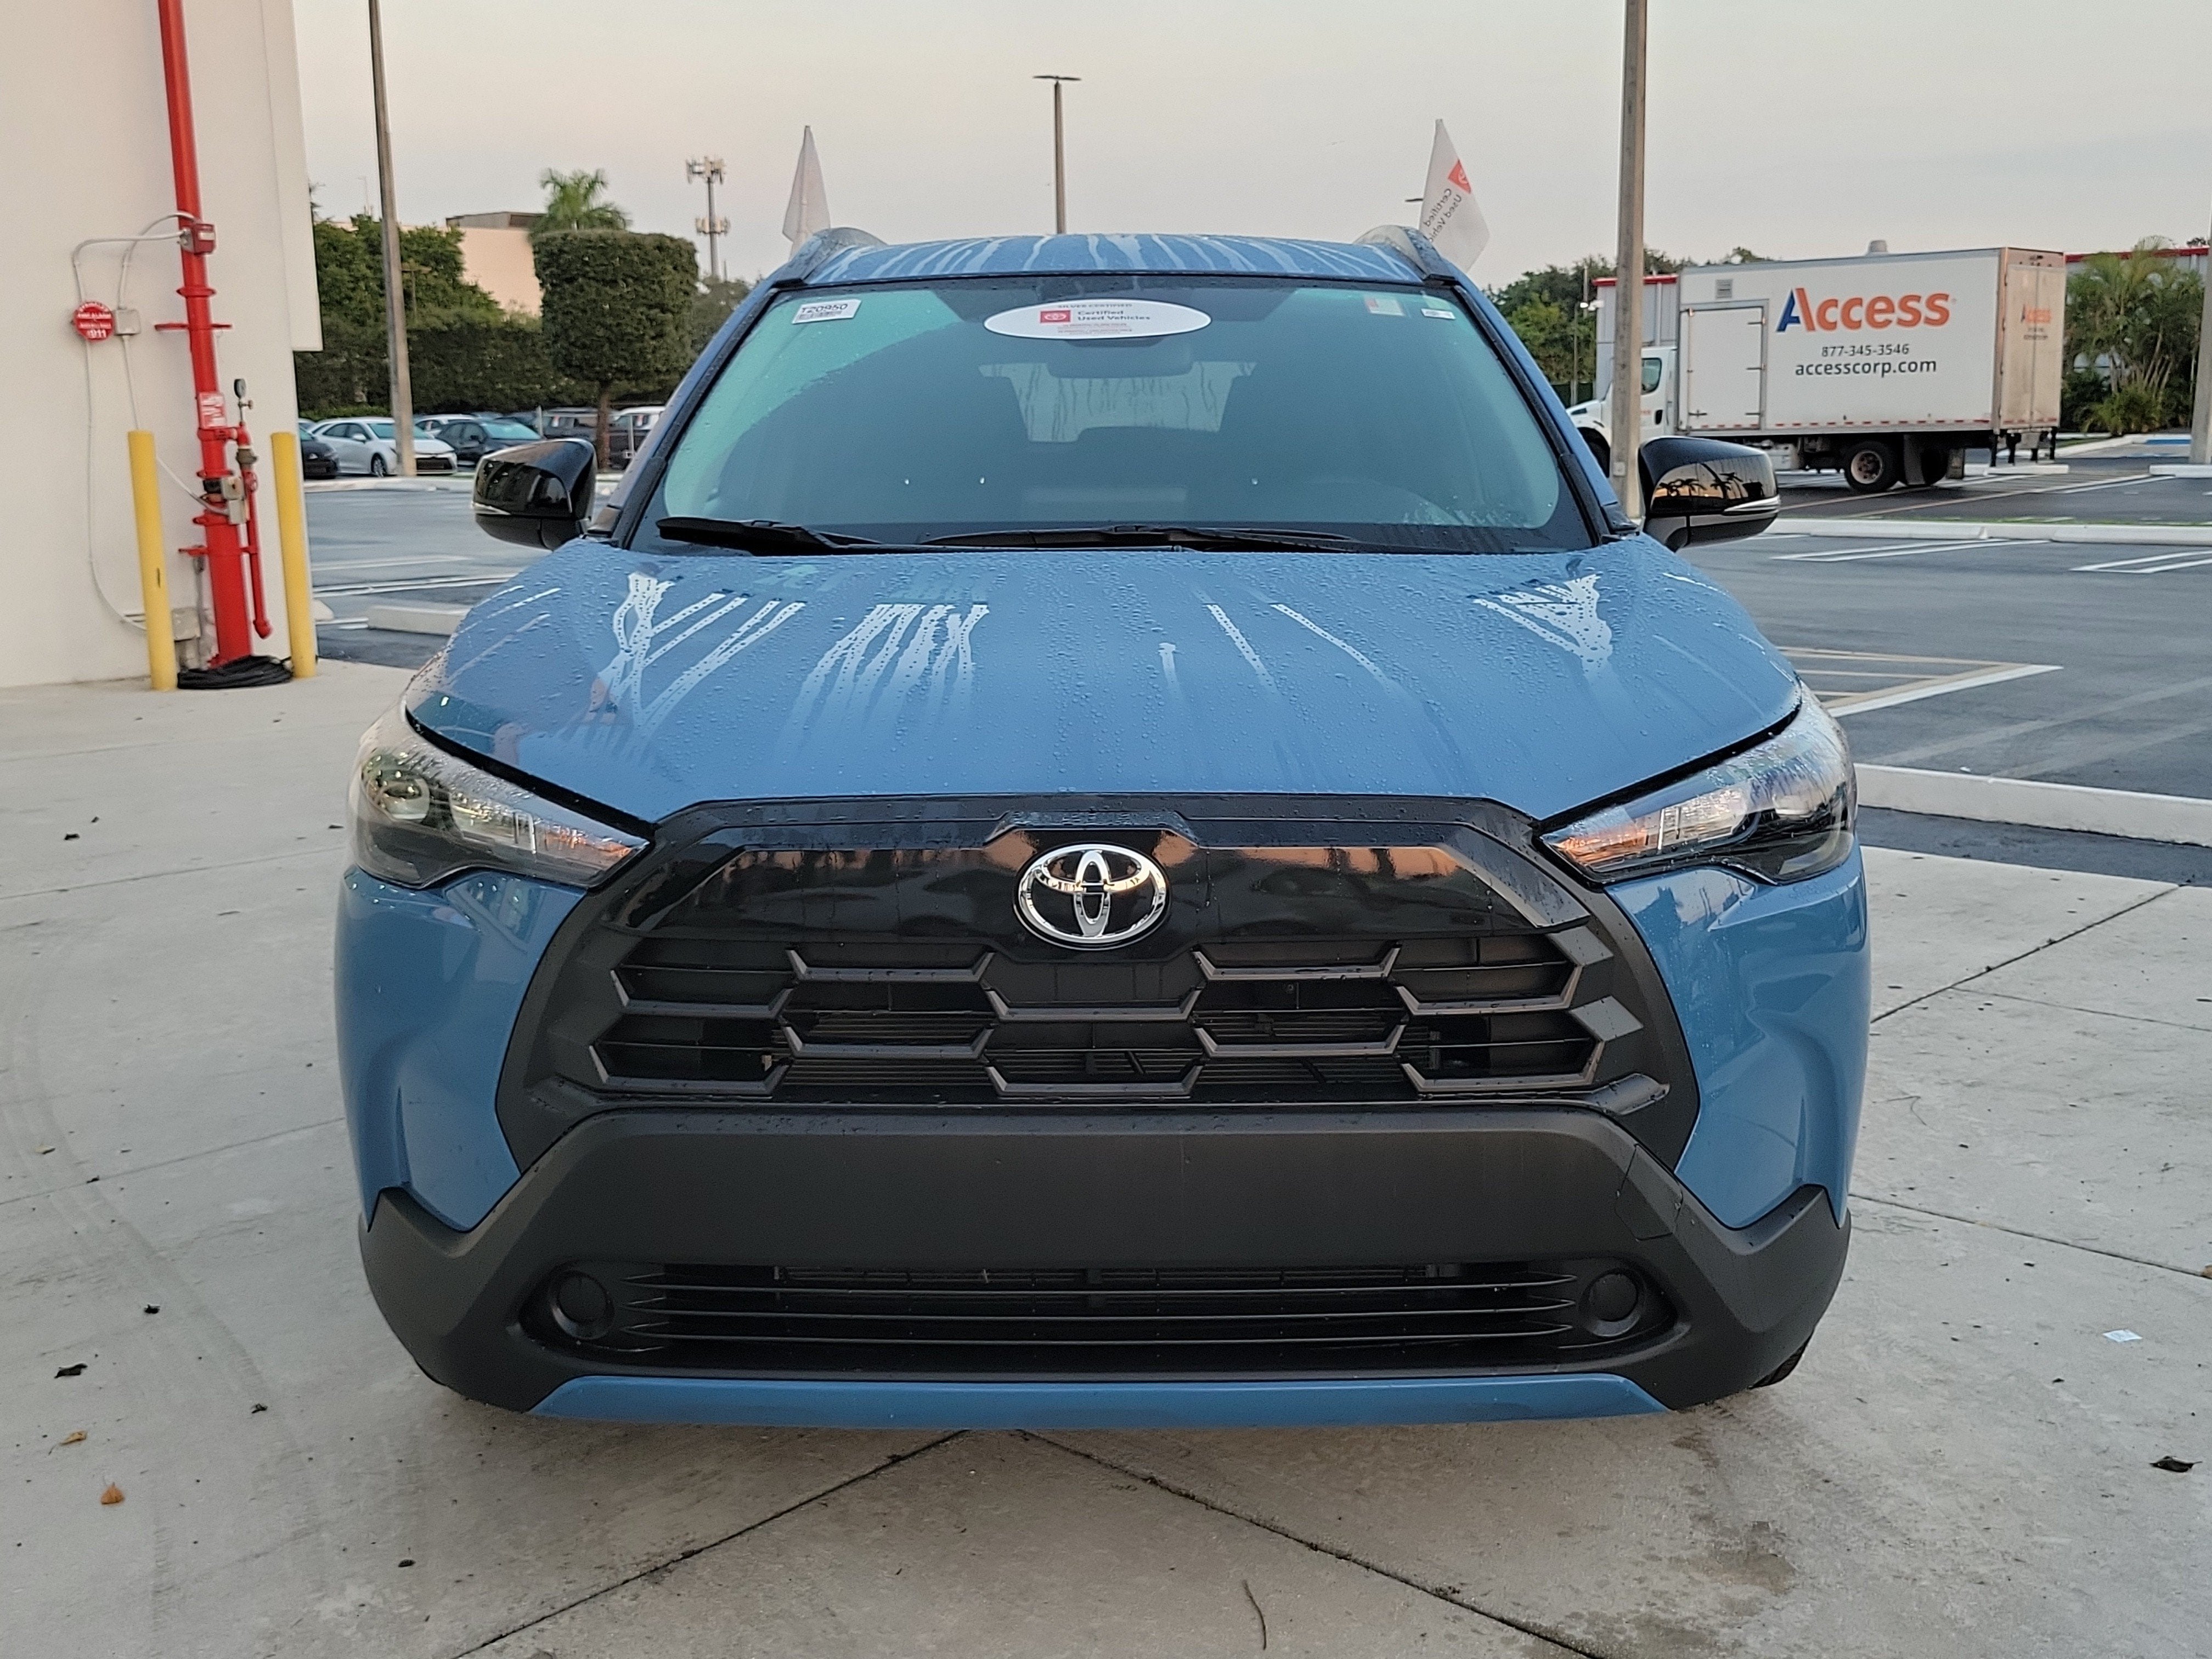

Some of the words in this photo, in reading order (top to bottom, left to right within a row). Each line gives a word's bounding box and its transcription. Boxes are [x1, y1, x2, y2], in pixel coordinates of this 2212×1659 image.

[1775, 287, 1950, 332] Access
[1821, 343, 1910, 357] 877-345-3546
[1795, 360, 1937, 378] accesscorp.com
